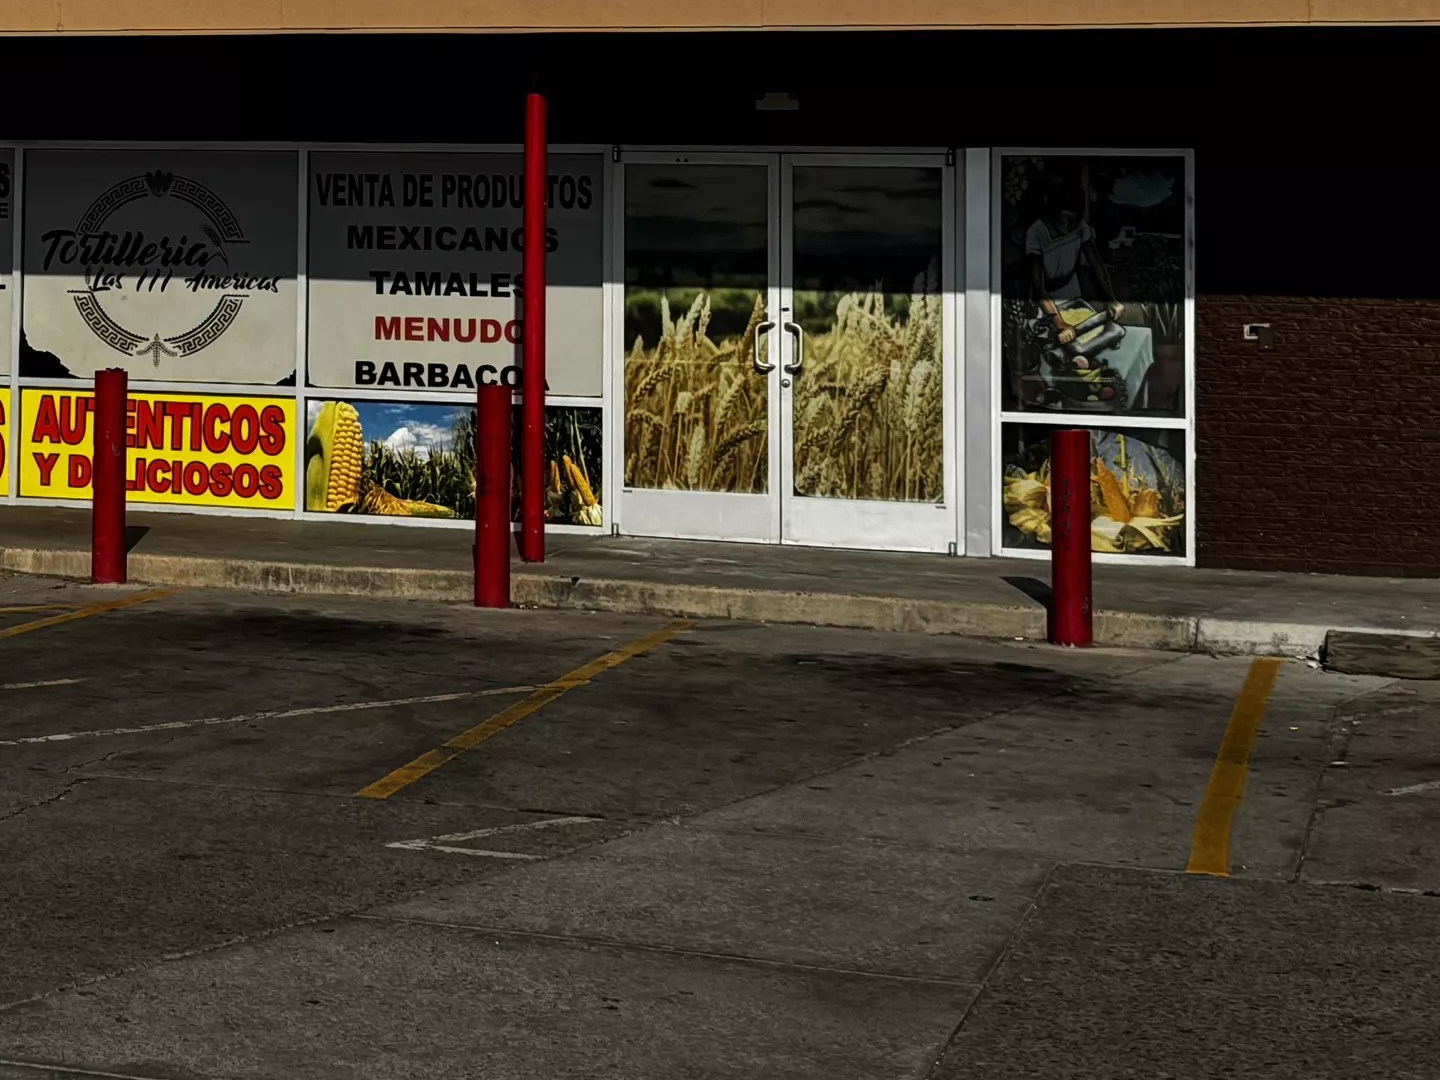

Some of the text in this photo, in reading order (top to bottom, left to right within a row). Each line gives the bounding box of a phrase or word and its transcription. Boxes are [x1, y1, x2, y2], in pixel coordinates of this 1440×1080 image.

[315, 173, 593, 208] VENTA DE PRODUTOS
[41, 229, 223, 270] Tortilleria
[90, 267, 127, 291] Las
[185, 269, 282, 291] Americas
[375, 316, 525, 343] MENUDO
[355, 360, 550, 389] BARBACO
[32, 453, 284, 498] Y DICIOSOS
